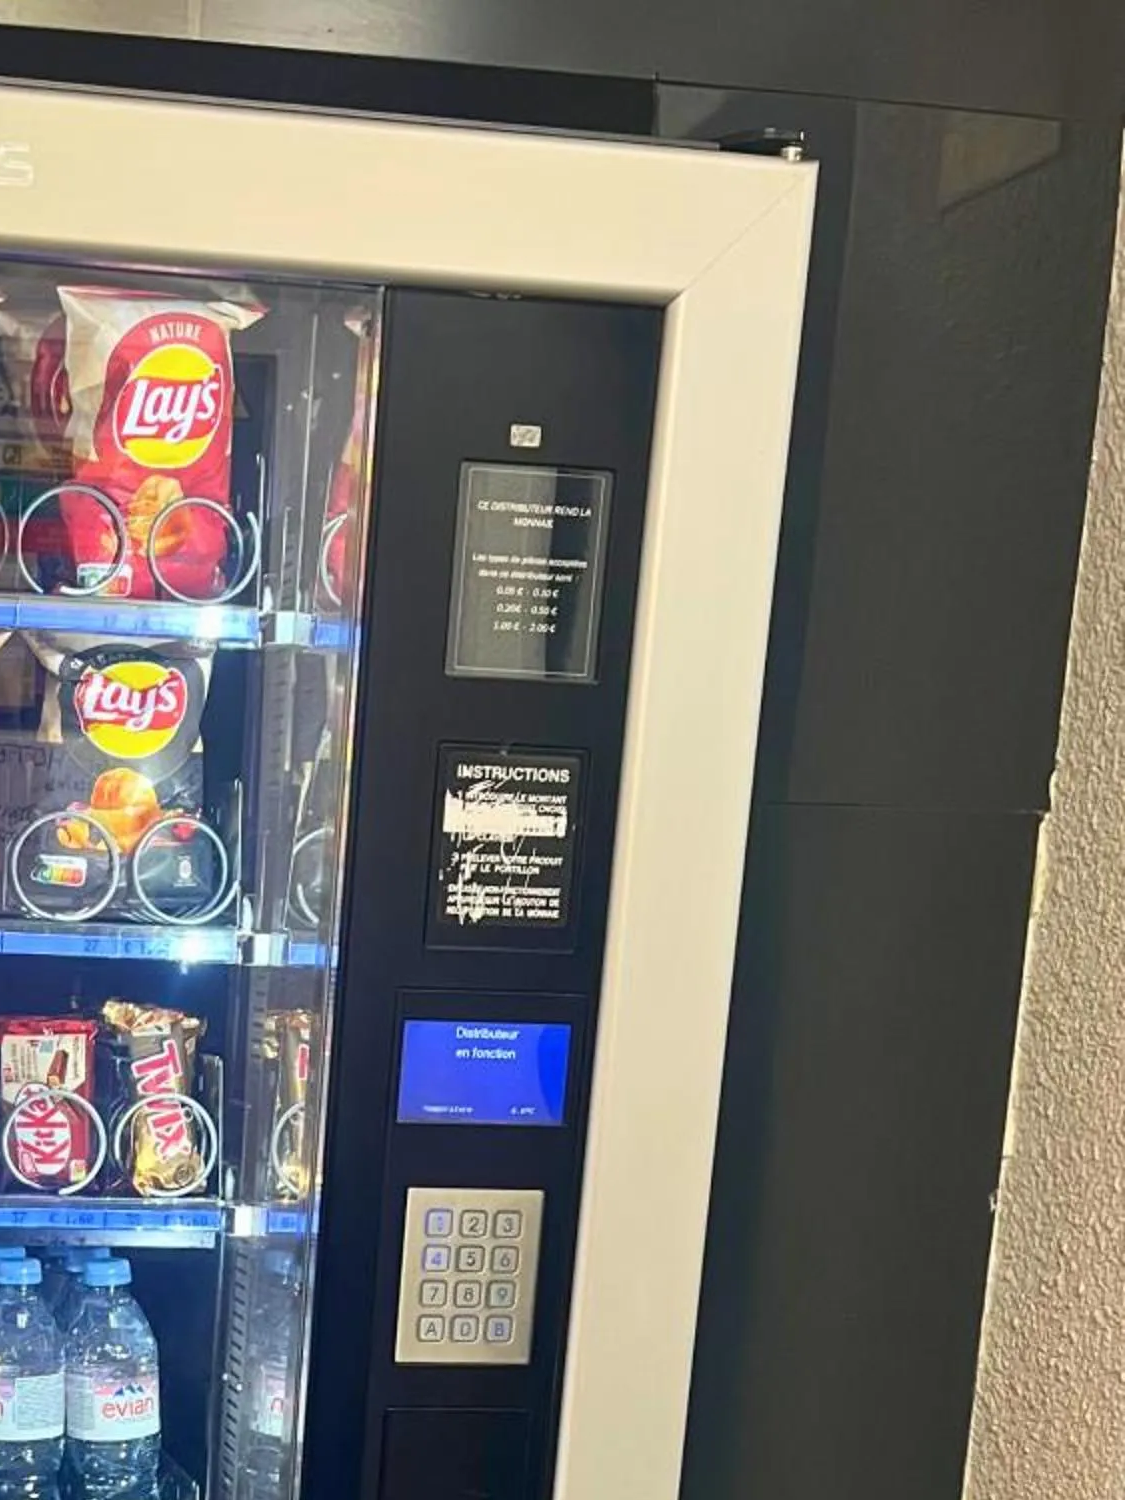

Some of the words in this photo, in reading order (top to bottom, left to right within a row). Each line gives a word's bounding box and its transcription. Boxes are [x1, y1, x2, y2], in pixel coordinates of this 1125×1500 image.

[149, 321, 202, 343] NATURE
[121, 375, 220, 443] Lay's
[554, 505, 579, 516] REND
[580, 508, 592, 517] LA
[82, 672, 180, 732] Lay's
[457, 763, 571, 783] INSTRUCTIONS
[456, 1026, 521, 1041] Distributeur
[455, 1049, 470, 1059] en
[472, 1048, 516, 1060] fonction
[131, 1039, 192, 1162] TWIX
[468, 1216, 480, 1233] 2
[502, 1217, 513, 1233] 3
[430, 1252, 442, 1266] 4
[465, 1252, 476, 1267] 5
[500, 1253, 511, 1267] 6
[429, 1287, 440, 1302] 7
[463, 1287, 474, 1302] 8
[497, 1287, 508, 1301] 9
[425, 1321, 438, 1336] A
[494, 1322, 504, 1337] B
[101, 1395, 155, 1419] evian
